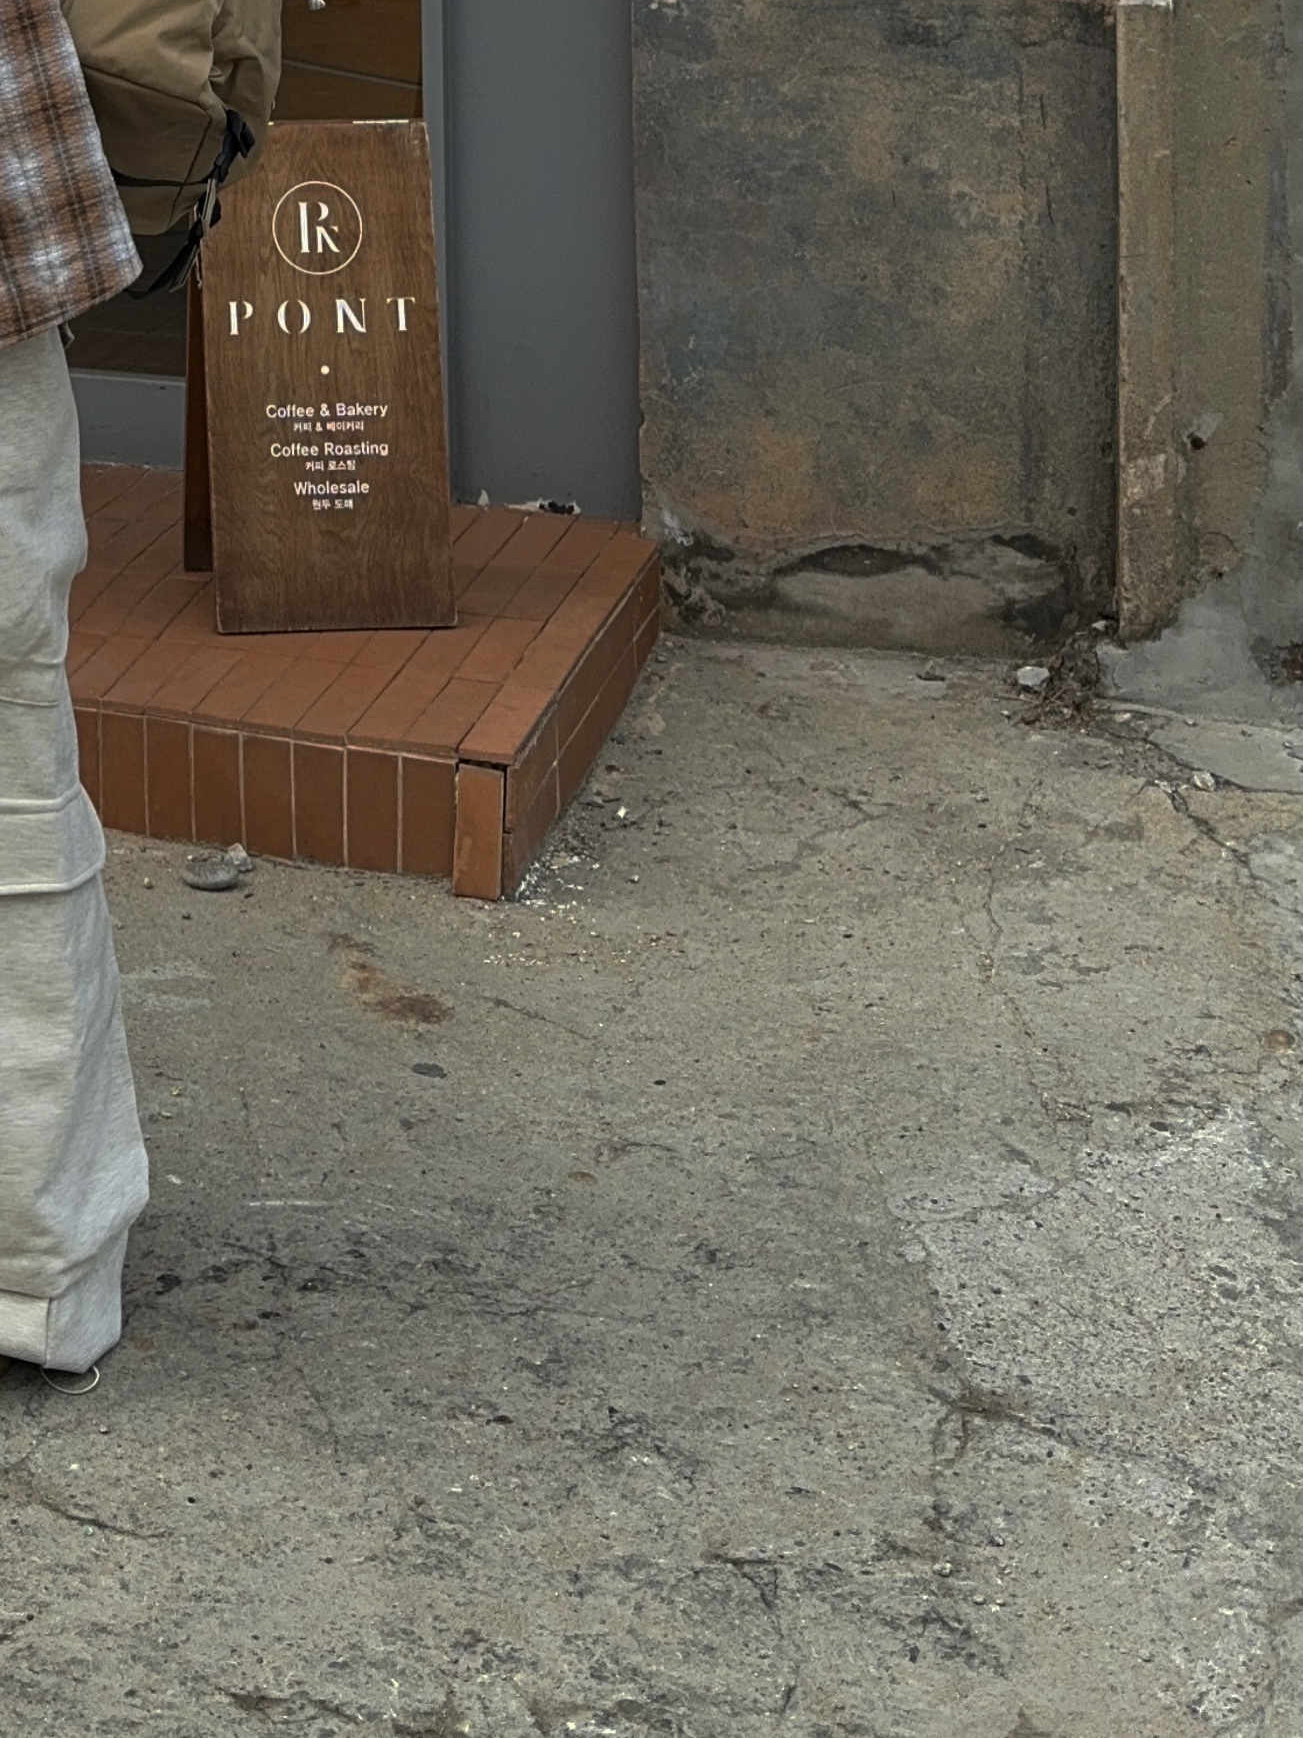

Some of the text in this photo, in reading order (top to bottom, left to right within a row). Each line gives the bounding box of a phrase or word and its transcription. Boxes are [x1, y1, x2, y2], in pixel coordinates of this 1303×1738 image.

[228, 296, 416, 336] PONT
[266, 402, 388, 418] Coffee & Bakery
[293, 421, 312, 432] 커피
[326, 420, 364, 432] 베이커리
[270, 441, 389, 457] Coffee Roasting
[305, 459, 356, 471] 커피 로스팅
[293, 479, 370, 495] Wholesale
[312, 498, 331, 510] 원두
